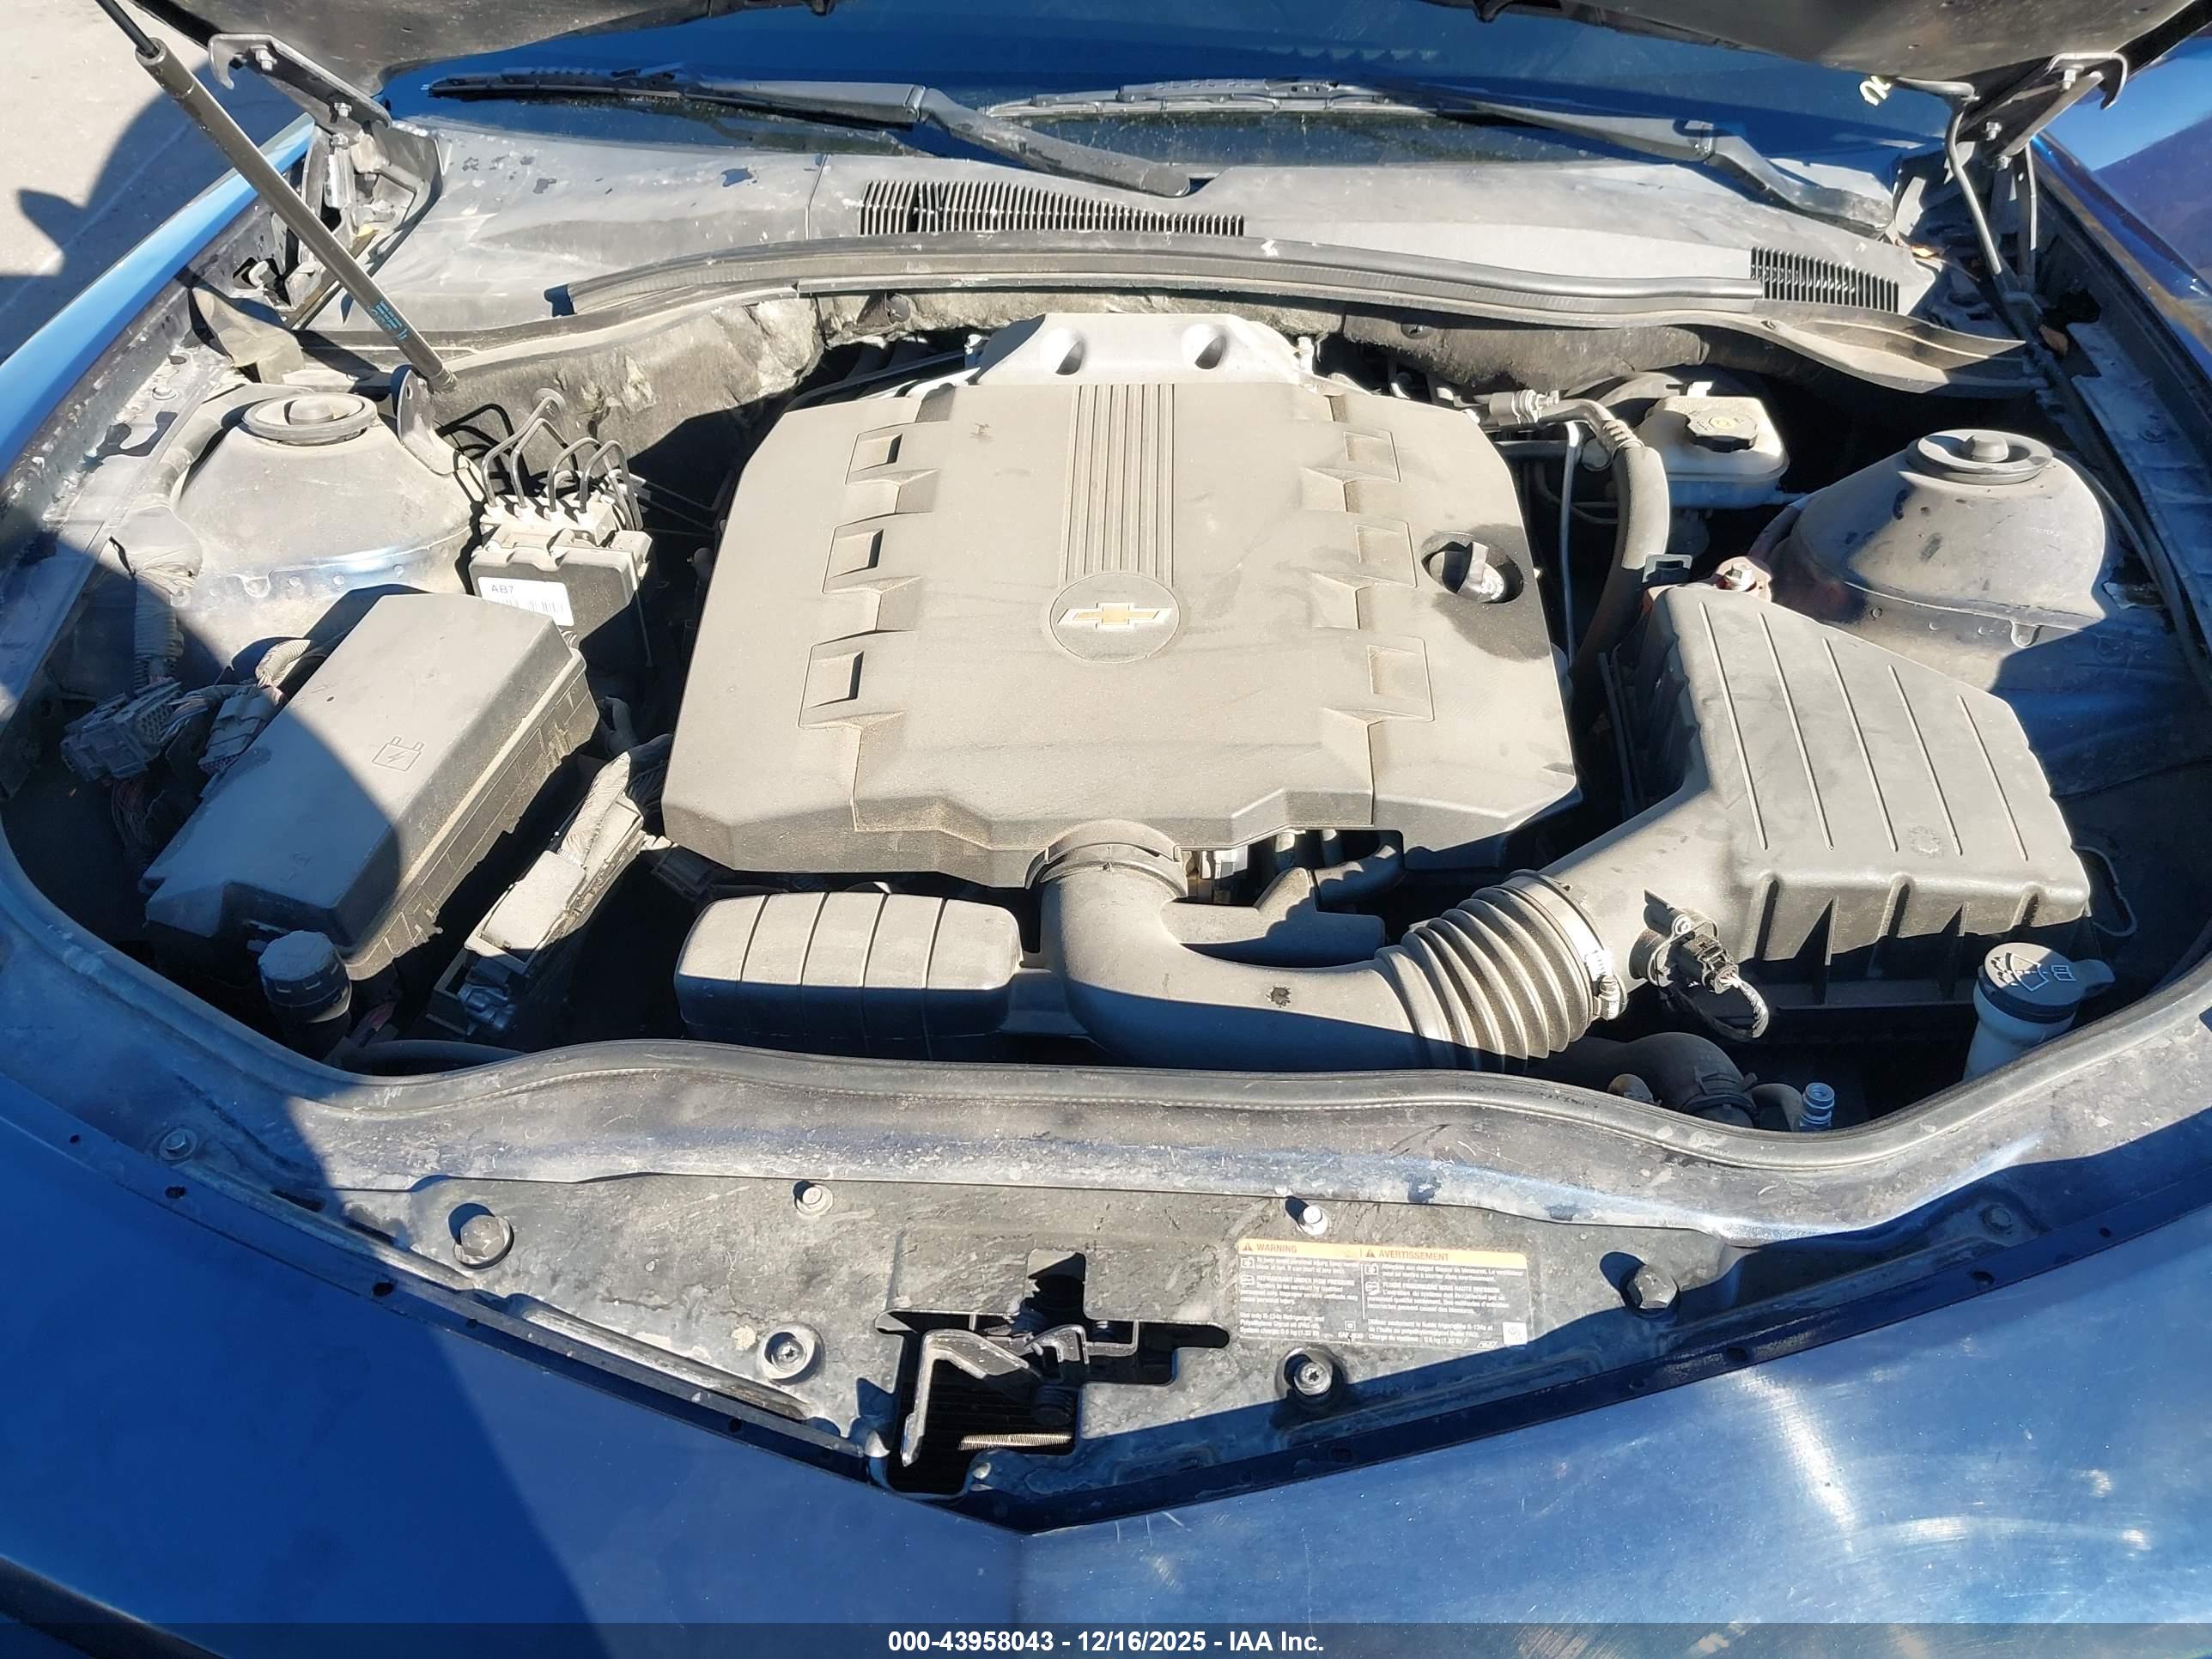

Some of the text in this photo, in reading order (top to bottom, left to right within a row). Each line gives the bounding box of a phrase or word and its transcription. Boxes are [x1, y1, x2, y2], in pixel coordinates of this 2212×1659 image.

[491, 584, 514, 594] AB7
[1256, 1243, 1297, 1254] WARNING
[1377, 1249, 1449, 1261] AVERTISSEMENT
